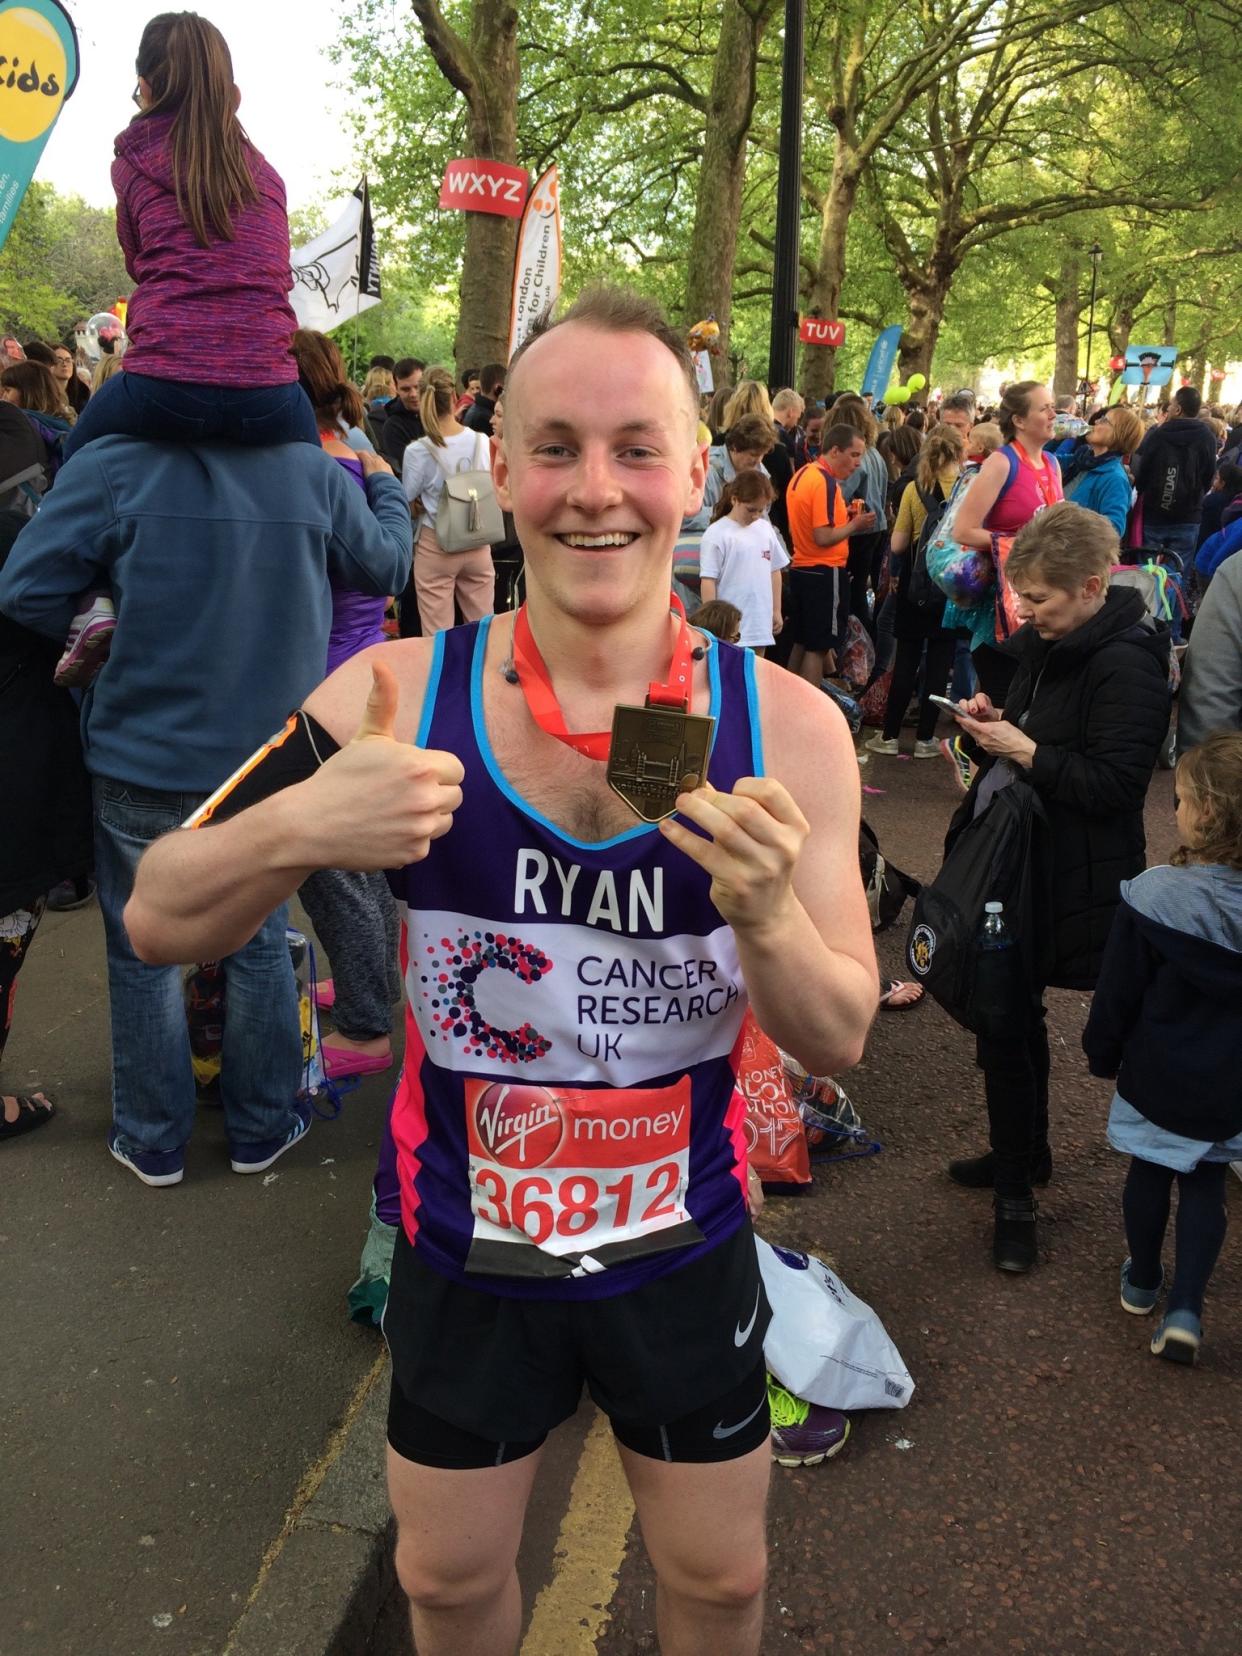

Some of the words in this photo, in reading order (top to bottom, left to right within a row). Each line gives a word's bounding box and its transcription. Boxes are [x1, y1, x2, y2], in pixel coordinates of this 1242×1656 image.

[0, 180, 19, 224] amilies
[449, 172, 522, 203] WXYZ
[534, 224, 551, 288] Children
[518, 267, 533, 322] London
[528, 292, 541, 313] for
[806, 322, 840, 340] TUV
[1161, 467, 1177, 511] ADIDAS
[514, 848, 664, 933] RYAN
[577, 956, 717, 991] CANCER
[577, 979, 739, 1025] RESEARCH
[577, 1033, 623, 1062] UK
[480, 1086, 559, 1162] Virgin
[574, 1105, 685, 1141] money
[475, 1162, 680, 1245] 36812
